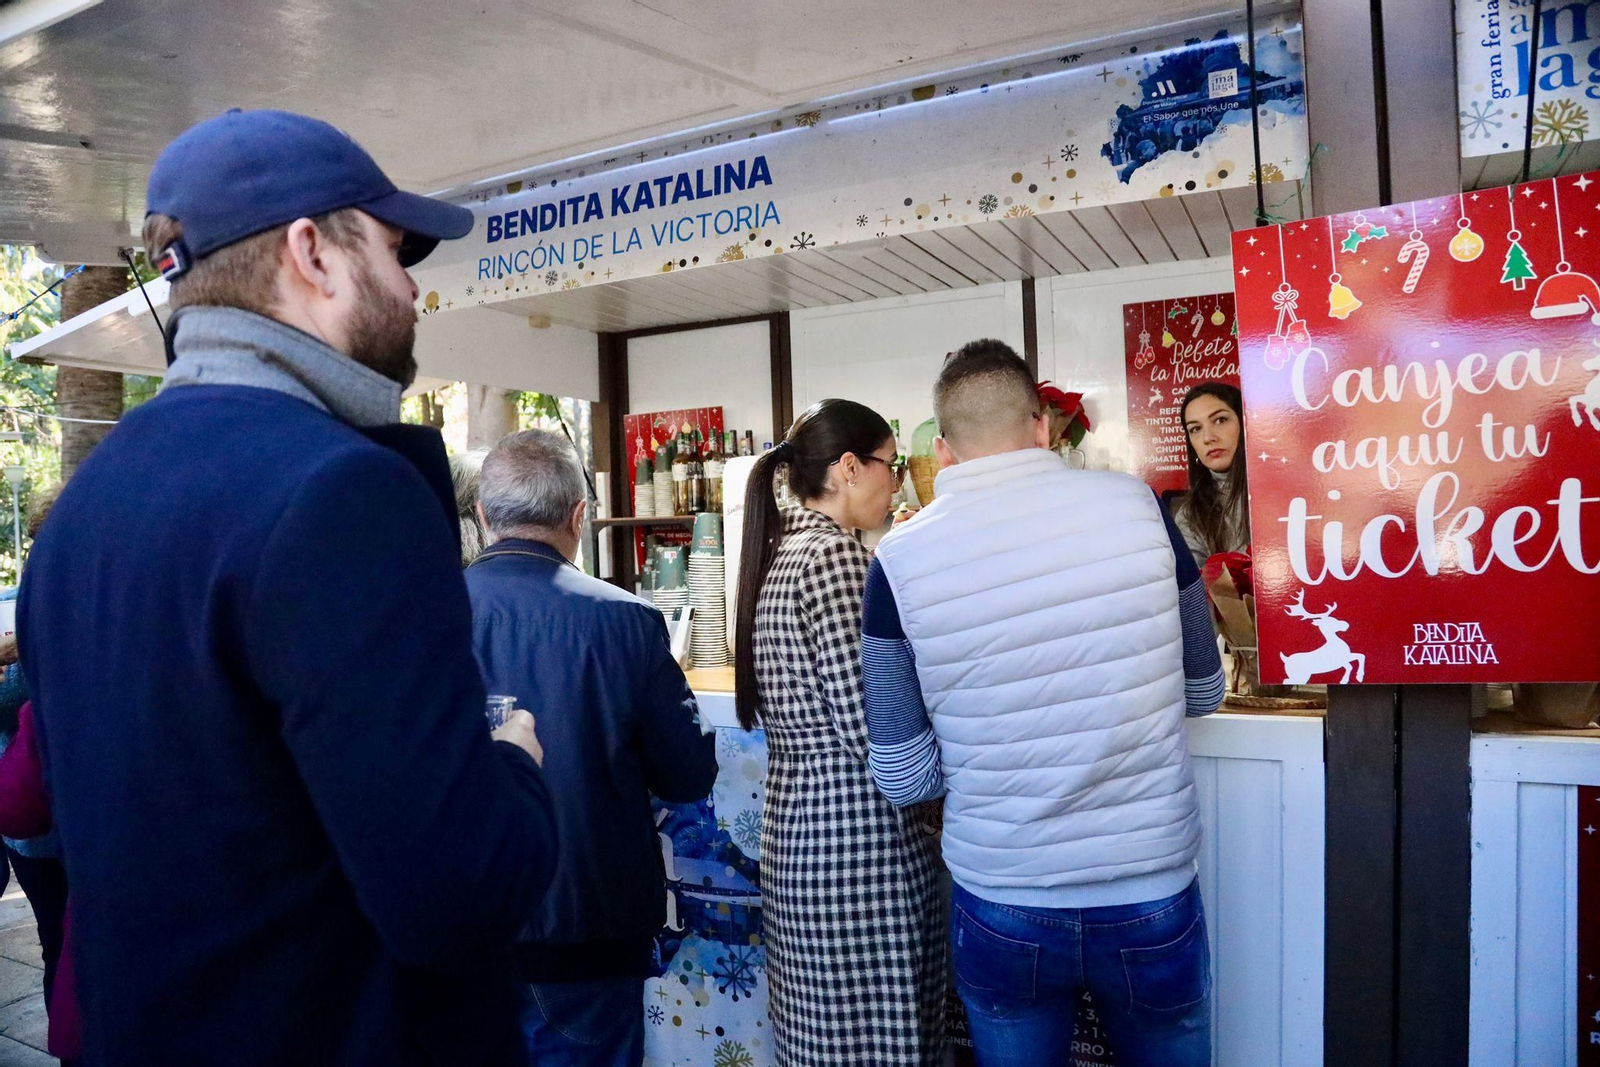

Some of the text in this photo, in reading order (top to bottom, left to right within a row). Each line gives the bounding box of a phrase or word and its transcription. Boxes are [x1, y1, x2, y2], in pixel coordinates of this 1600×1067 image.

[1490, 52, 1511, 99] gran
[1143, 115, 1151, 123] El
[1153, 111, 1179, 121] Sabor
[1182, 108, 1199, 117] que
[1220, 101, 1239, 110] Une
[487, 155, 773, 243] BENDITA KATALINA
[477, 200, 782, 281] RINCÓN DE LA VICTORIA
[1150, 365, 1171, 382] la
[1291, 341, 1561, 429] Canjea
[1144, 417, 1173, 425] TINTO
[1475, 412, 1550, 463] tu
[1277, 471, 1600, 586] ticket
[1412, 622, 1487, 644] BENDITA
[1403, 645, 1499, 666] KATALINA
[1081, 990, 1092, 1003] 4
